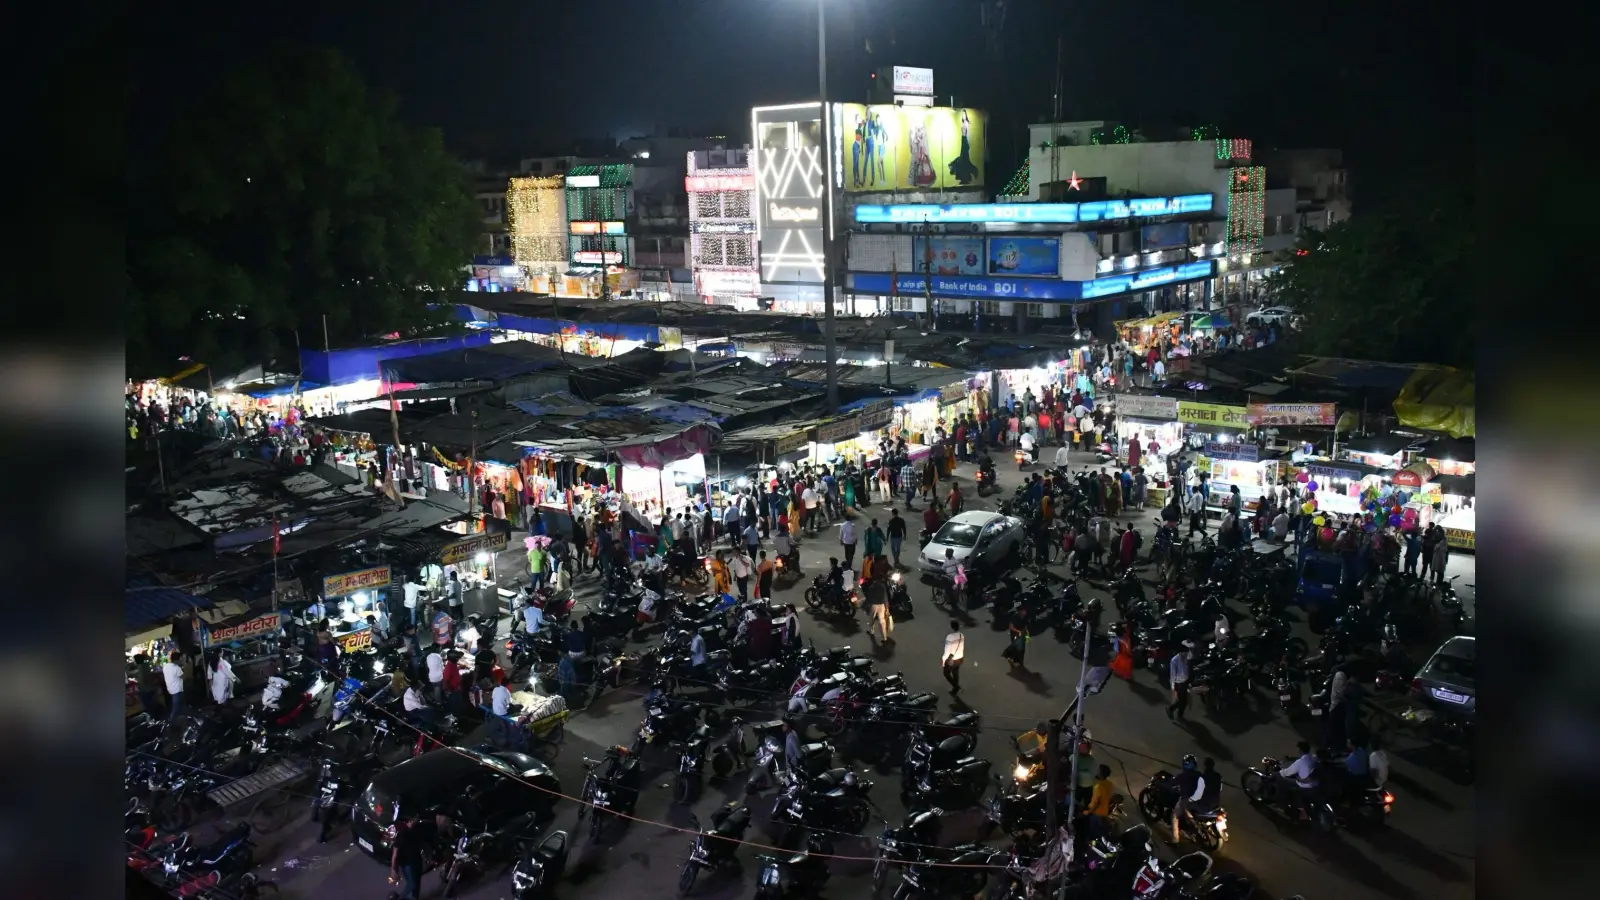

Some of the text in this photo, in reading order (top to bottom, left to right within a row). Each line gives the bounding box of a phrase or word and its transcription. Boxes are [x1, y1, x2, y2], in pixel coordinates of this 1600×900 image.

[940, 281, 1016, 293] Bank of India BOI
[1180, 408, 1217, 421] मसाला
[1307, 466, 1335, 475] SANJAY
[451, 540, 482, 556] मसाला
